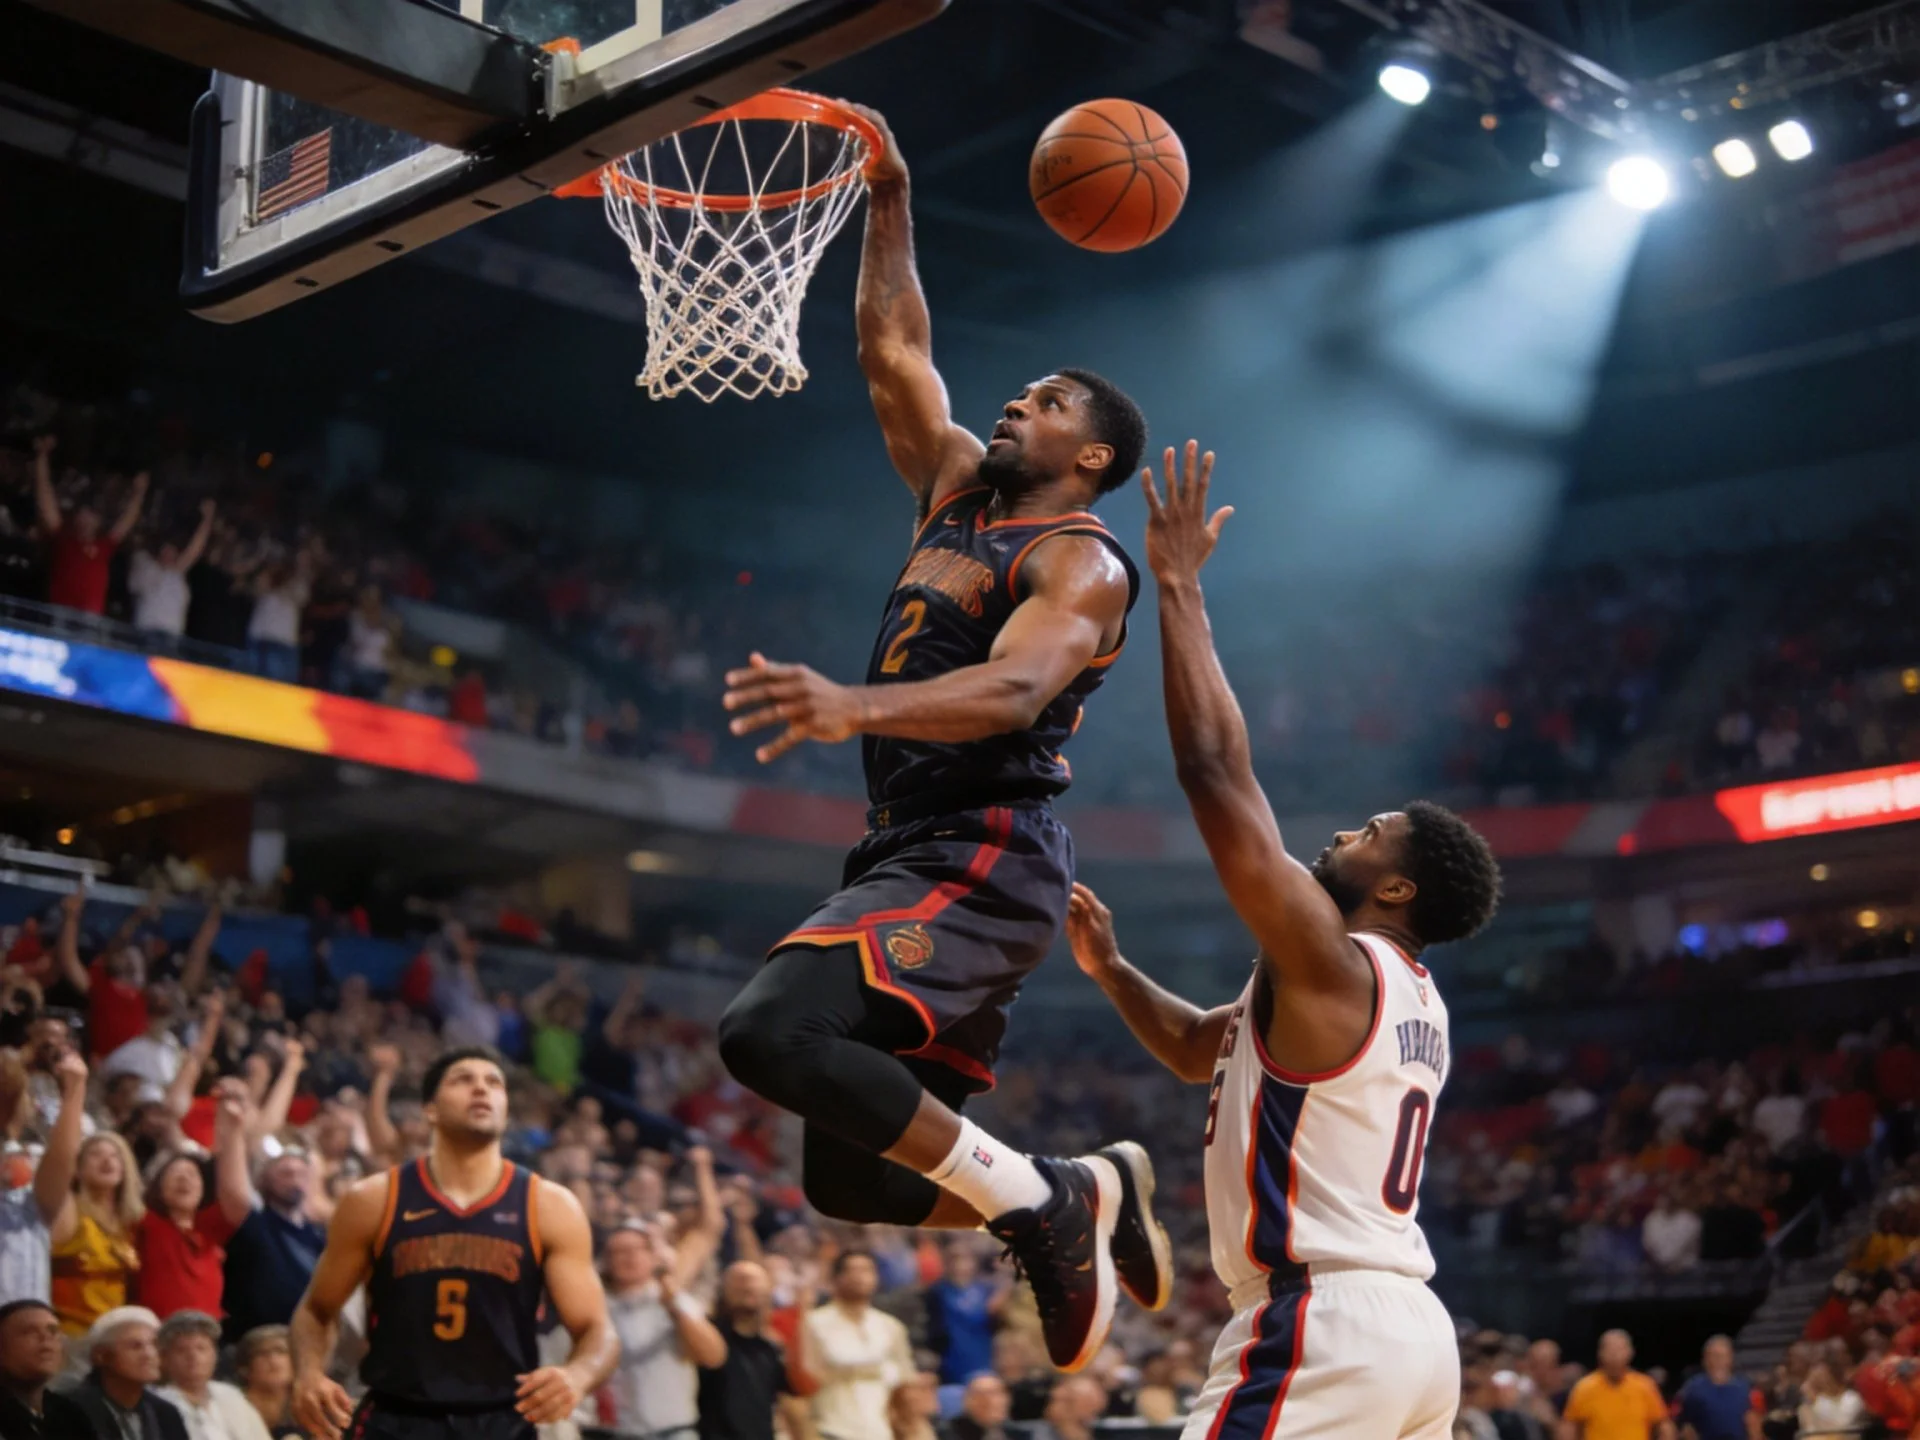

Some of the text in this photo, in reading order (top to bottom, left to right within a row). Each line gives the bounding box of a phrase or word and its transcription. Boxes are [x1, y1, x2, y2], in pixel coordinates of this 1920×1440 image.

[880, 599, 927, 673] 2
[1381, 1085, 1430, 1215] 0
[433, 1278, 469, 1341] 5
